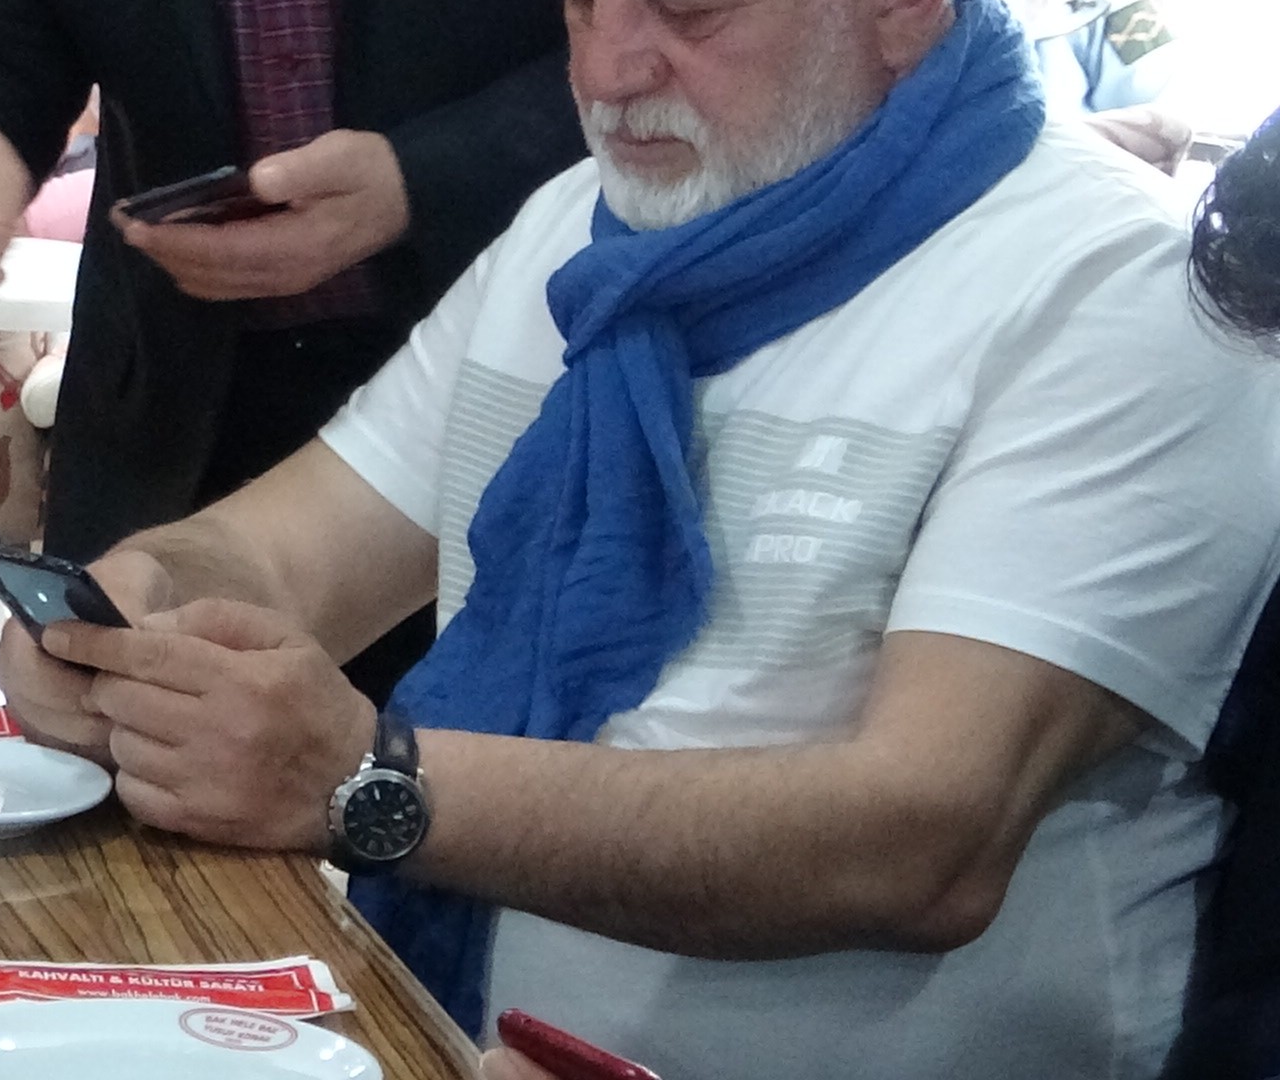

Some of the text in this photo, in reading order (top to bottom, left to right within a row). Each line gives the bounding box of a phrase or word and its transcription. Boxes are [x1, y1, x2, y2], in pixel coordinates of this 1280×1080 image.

[745, 533, 822, 563] PRO
[18, 969, 105, 984] KAHVALTI
[108, 974, 124, 985] &
